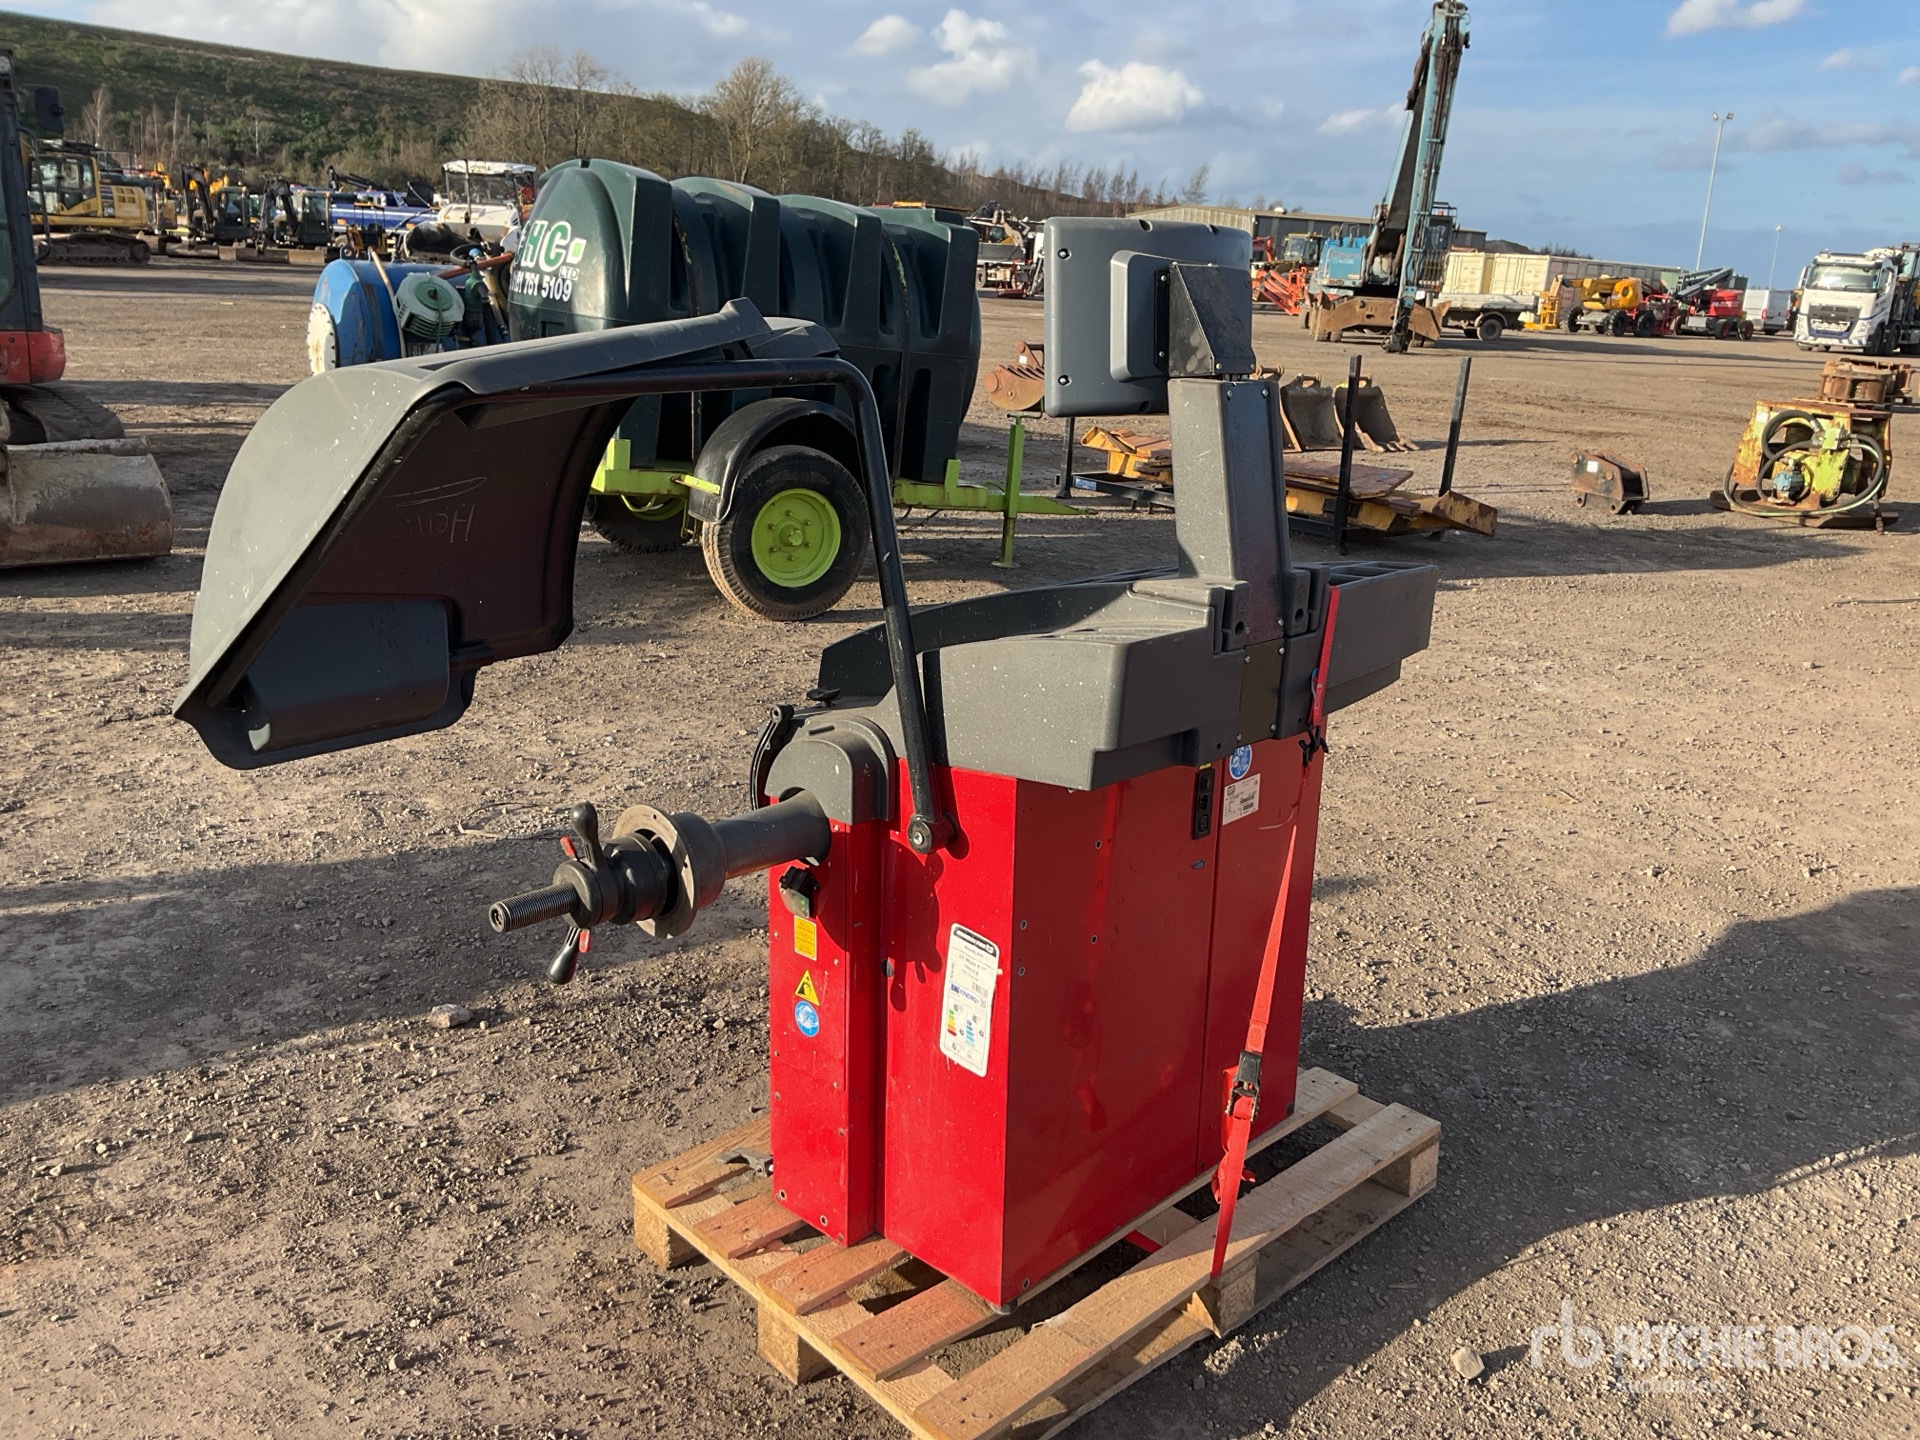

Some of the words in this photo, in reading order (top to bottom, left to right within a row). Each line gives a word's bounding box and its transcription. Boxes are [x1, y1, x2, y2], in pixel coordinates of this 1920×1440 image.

[560, 266, 579, 280] LTD
[523, 272, 540, 296] 761
[541, 275, 572, 301] 5109
